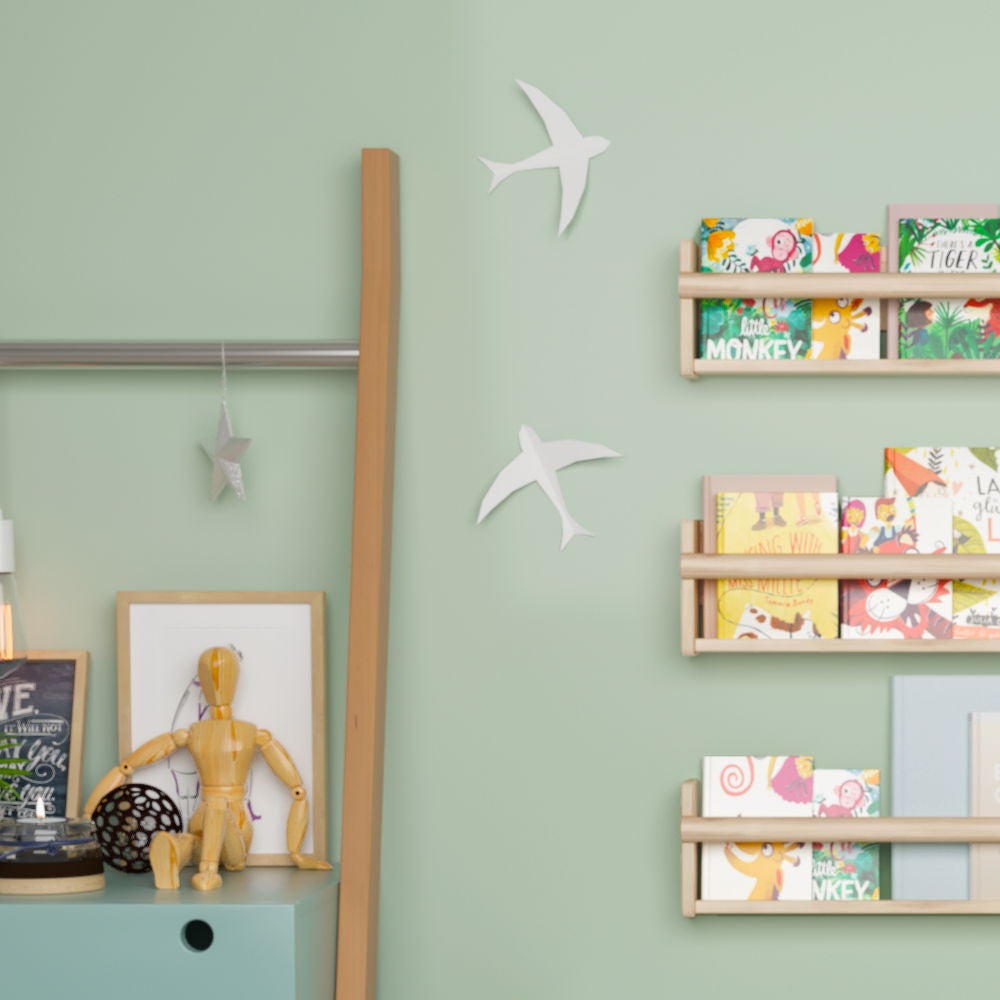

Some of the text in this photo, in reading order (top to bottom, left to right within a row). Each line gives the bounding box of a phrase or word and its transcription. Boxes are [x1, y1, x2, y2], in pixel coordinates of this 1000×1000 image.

[929, 249, 979, 270] TIGER
[741, 316, 769, 336] little
[706, 338, 803, 359] MONKEY
[812, 860, 837, 877] ittle
[811, 880, 870, 900] NKEY
